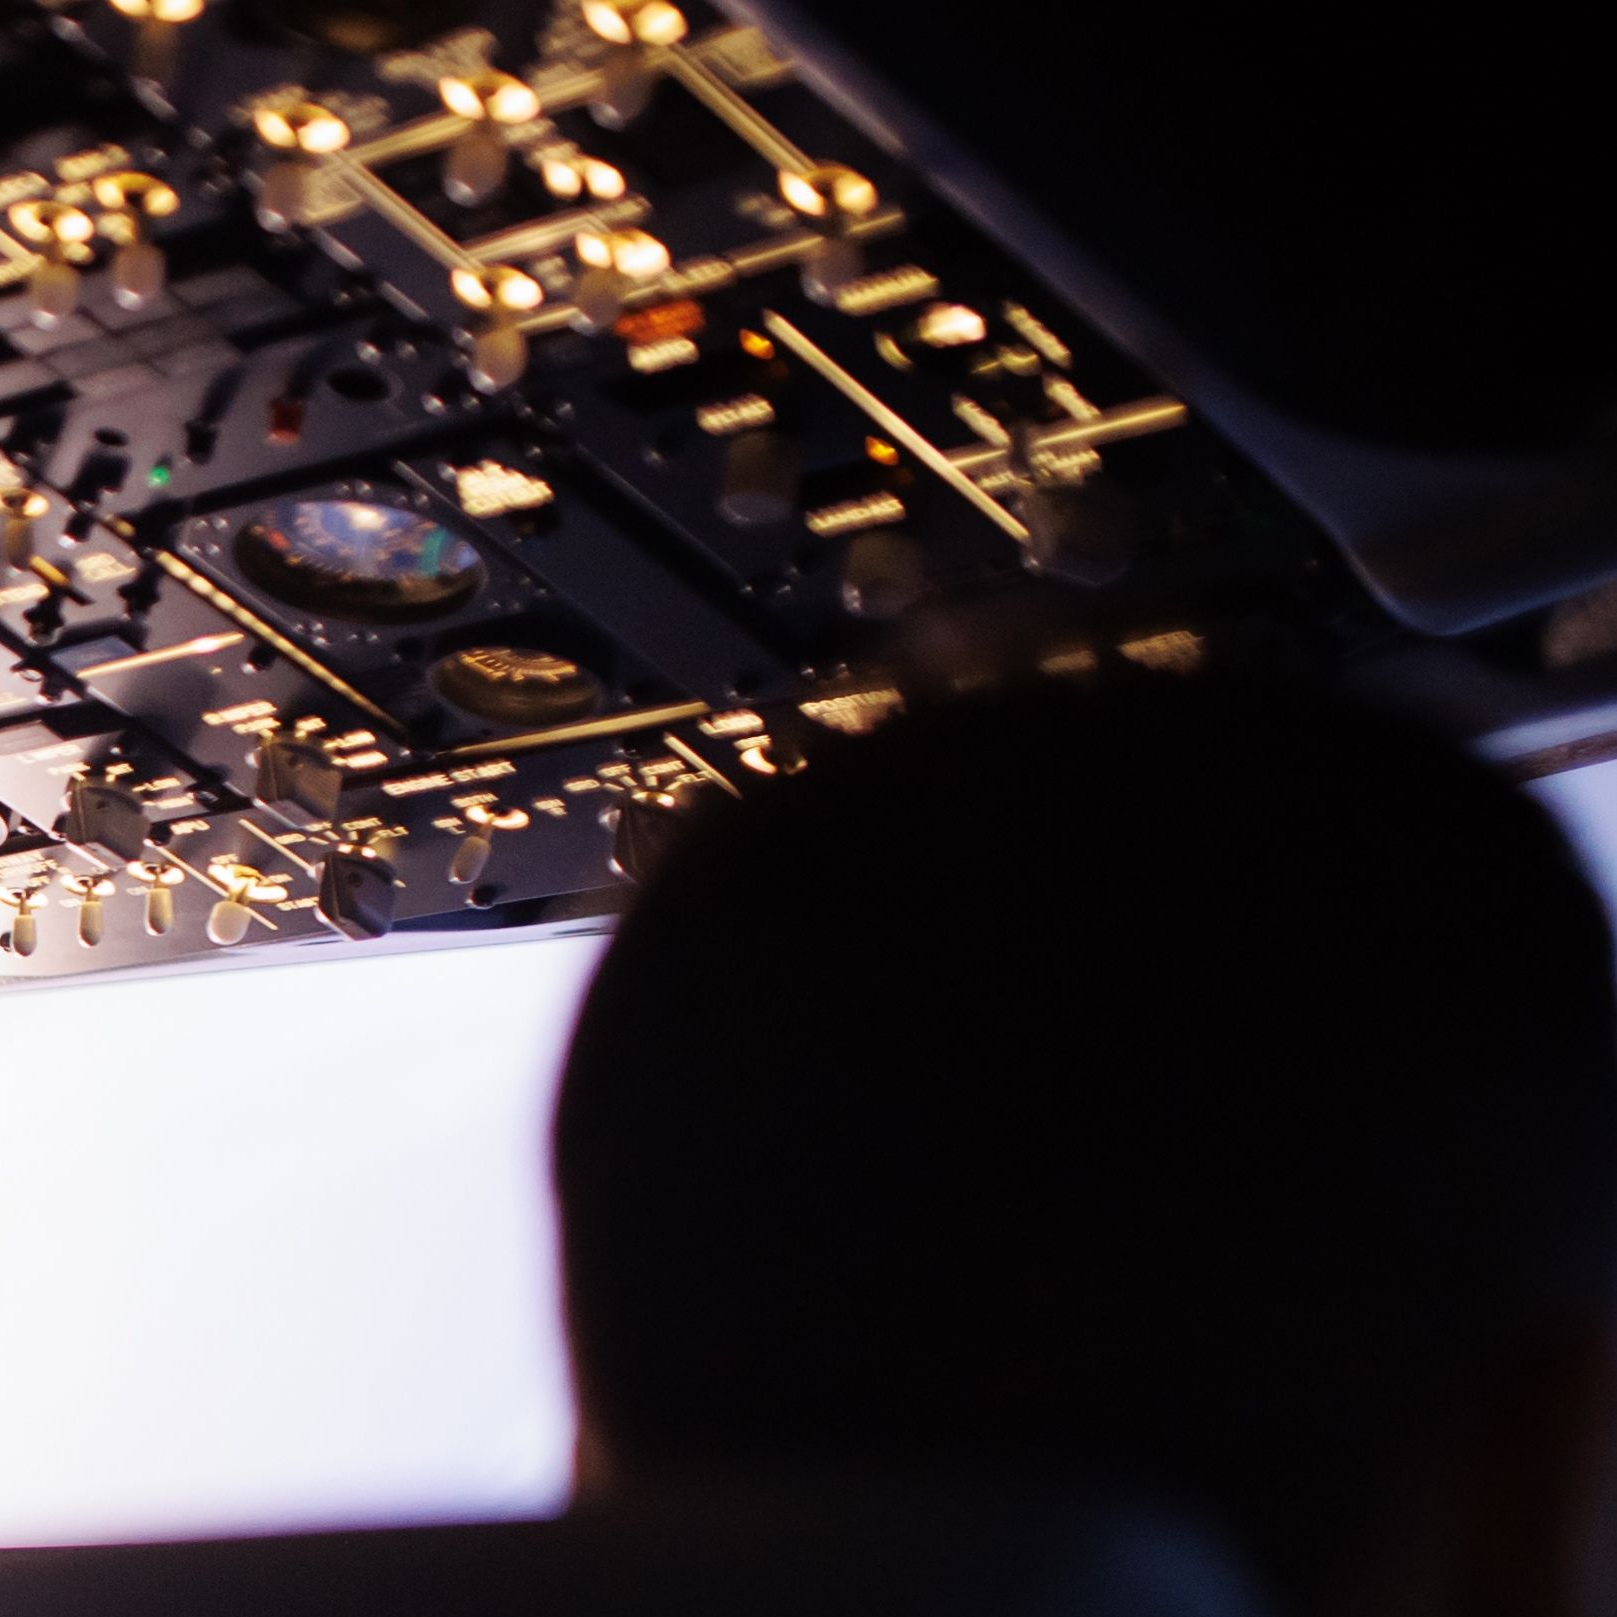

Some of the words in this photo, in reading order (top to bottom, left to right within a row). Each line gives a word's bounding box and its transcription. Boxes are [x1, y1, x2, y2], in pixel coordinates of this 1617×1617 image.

[639, 760, 685, 776] CONT
[382, 774, 454, 796] ENGINE
[449, 761, 516, 782] START
[342, 817, 382, 831] CONT
[376, 826, 409, 838] FLT
